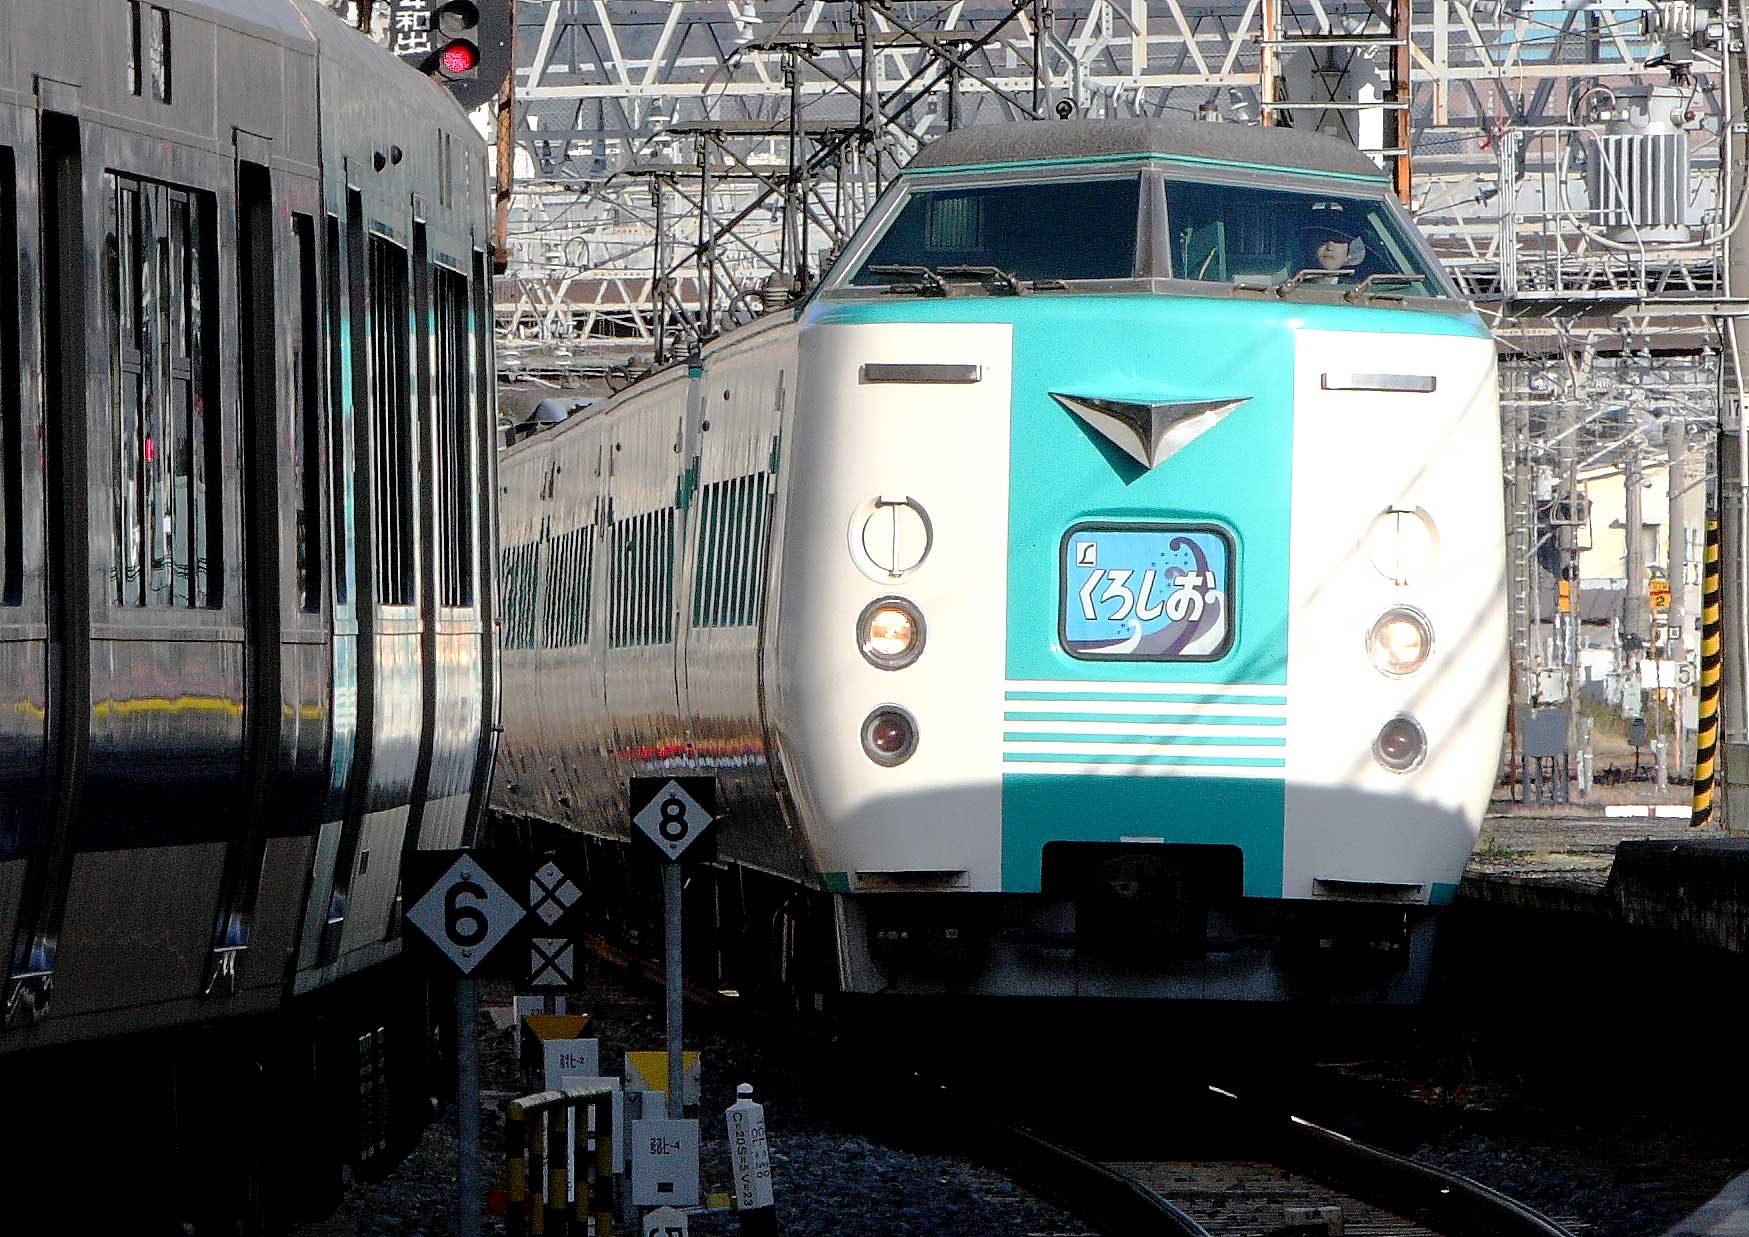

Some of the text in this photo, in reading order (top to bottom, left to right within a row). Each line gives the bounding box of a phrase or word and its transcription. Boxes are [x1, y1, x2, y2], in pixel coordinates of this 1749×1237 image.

[1078, 568, 1217, 621] くろしお
[1678, 663, 1690, 684] 5
[658, 798, 689, 843] 8
[444, 880, 489, 947] 6
